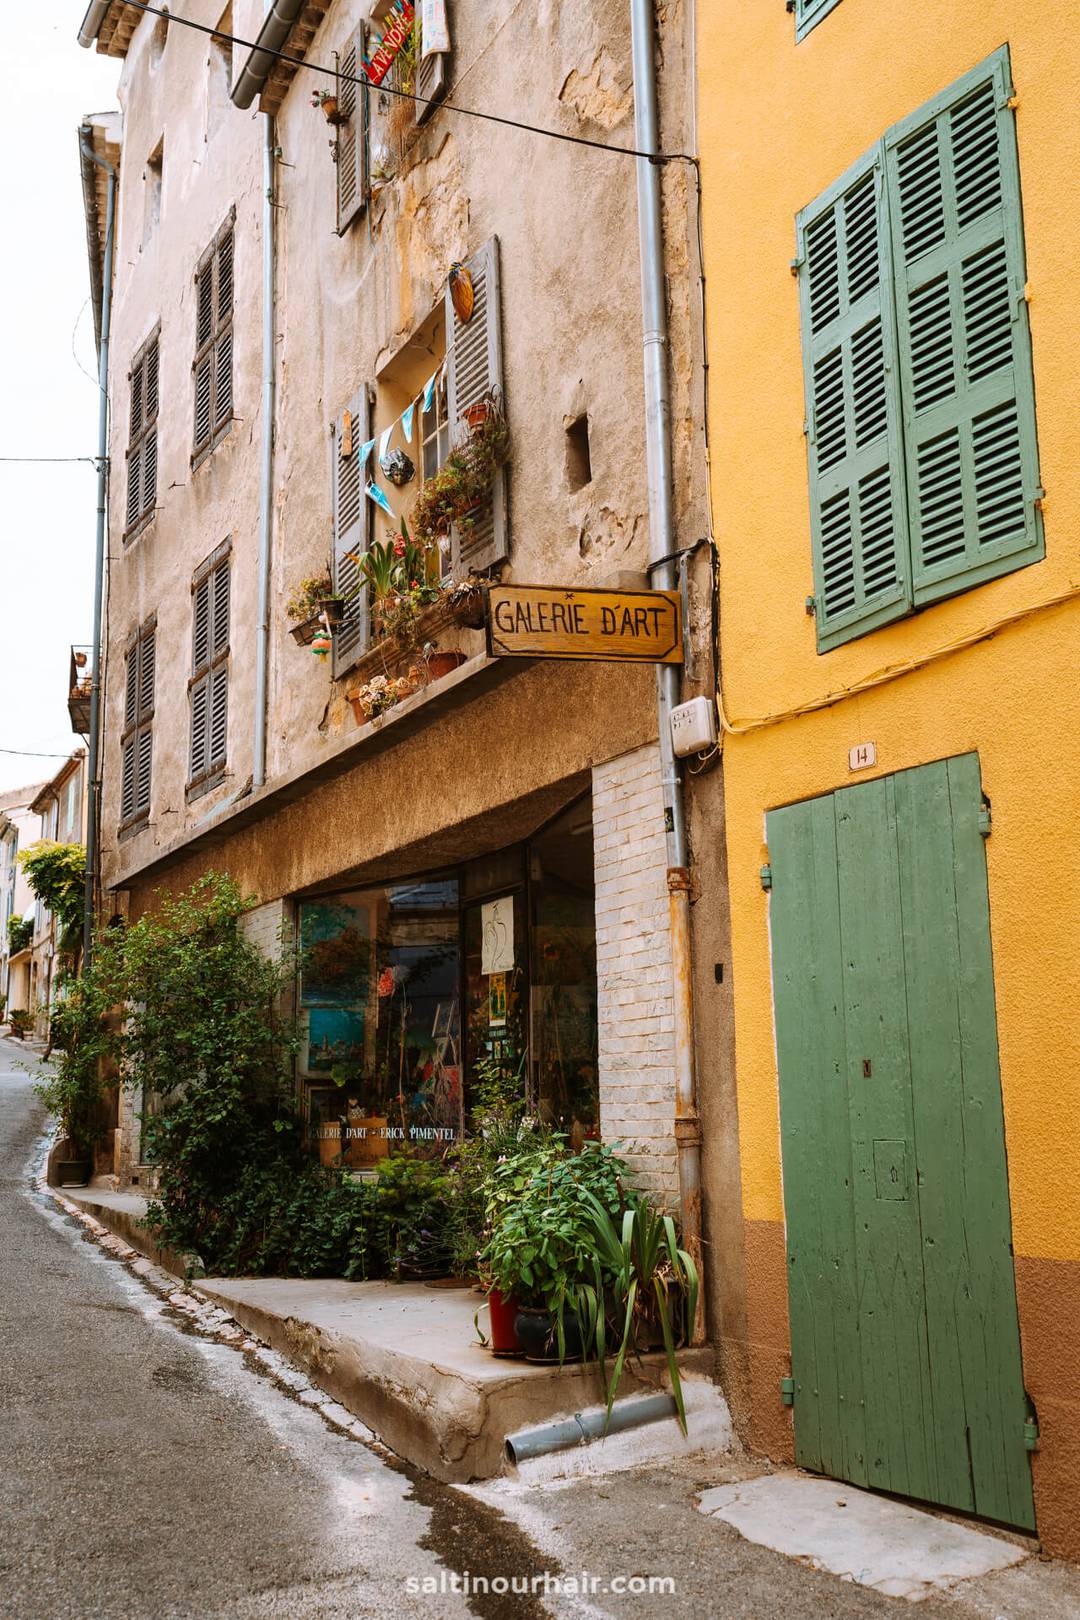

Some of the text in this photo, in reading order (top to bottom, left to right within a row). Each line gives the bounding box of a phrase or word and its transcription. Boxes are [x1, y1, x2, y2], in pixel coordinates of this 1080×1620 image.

[495, 600, 590, 634] GALERIE
[857, 747, 868, 764] 14
[380, 1127, 405, 1139] ERICK
